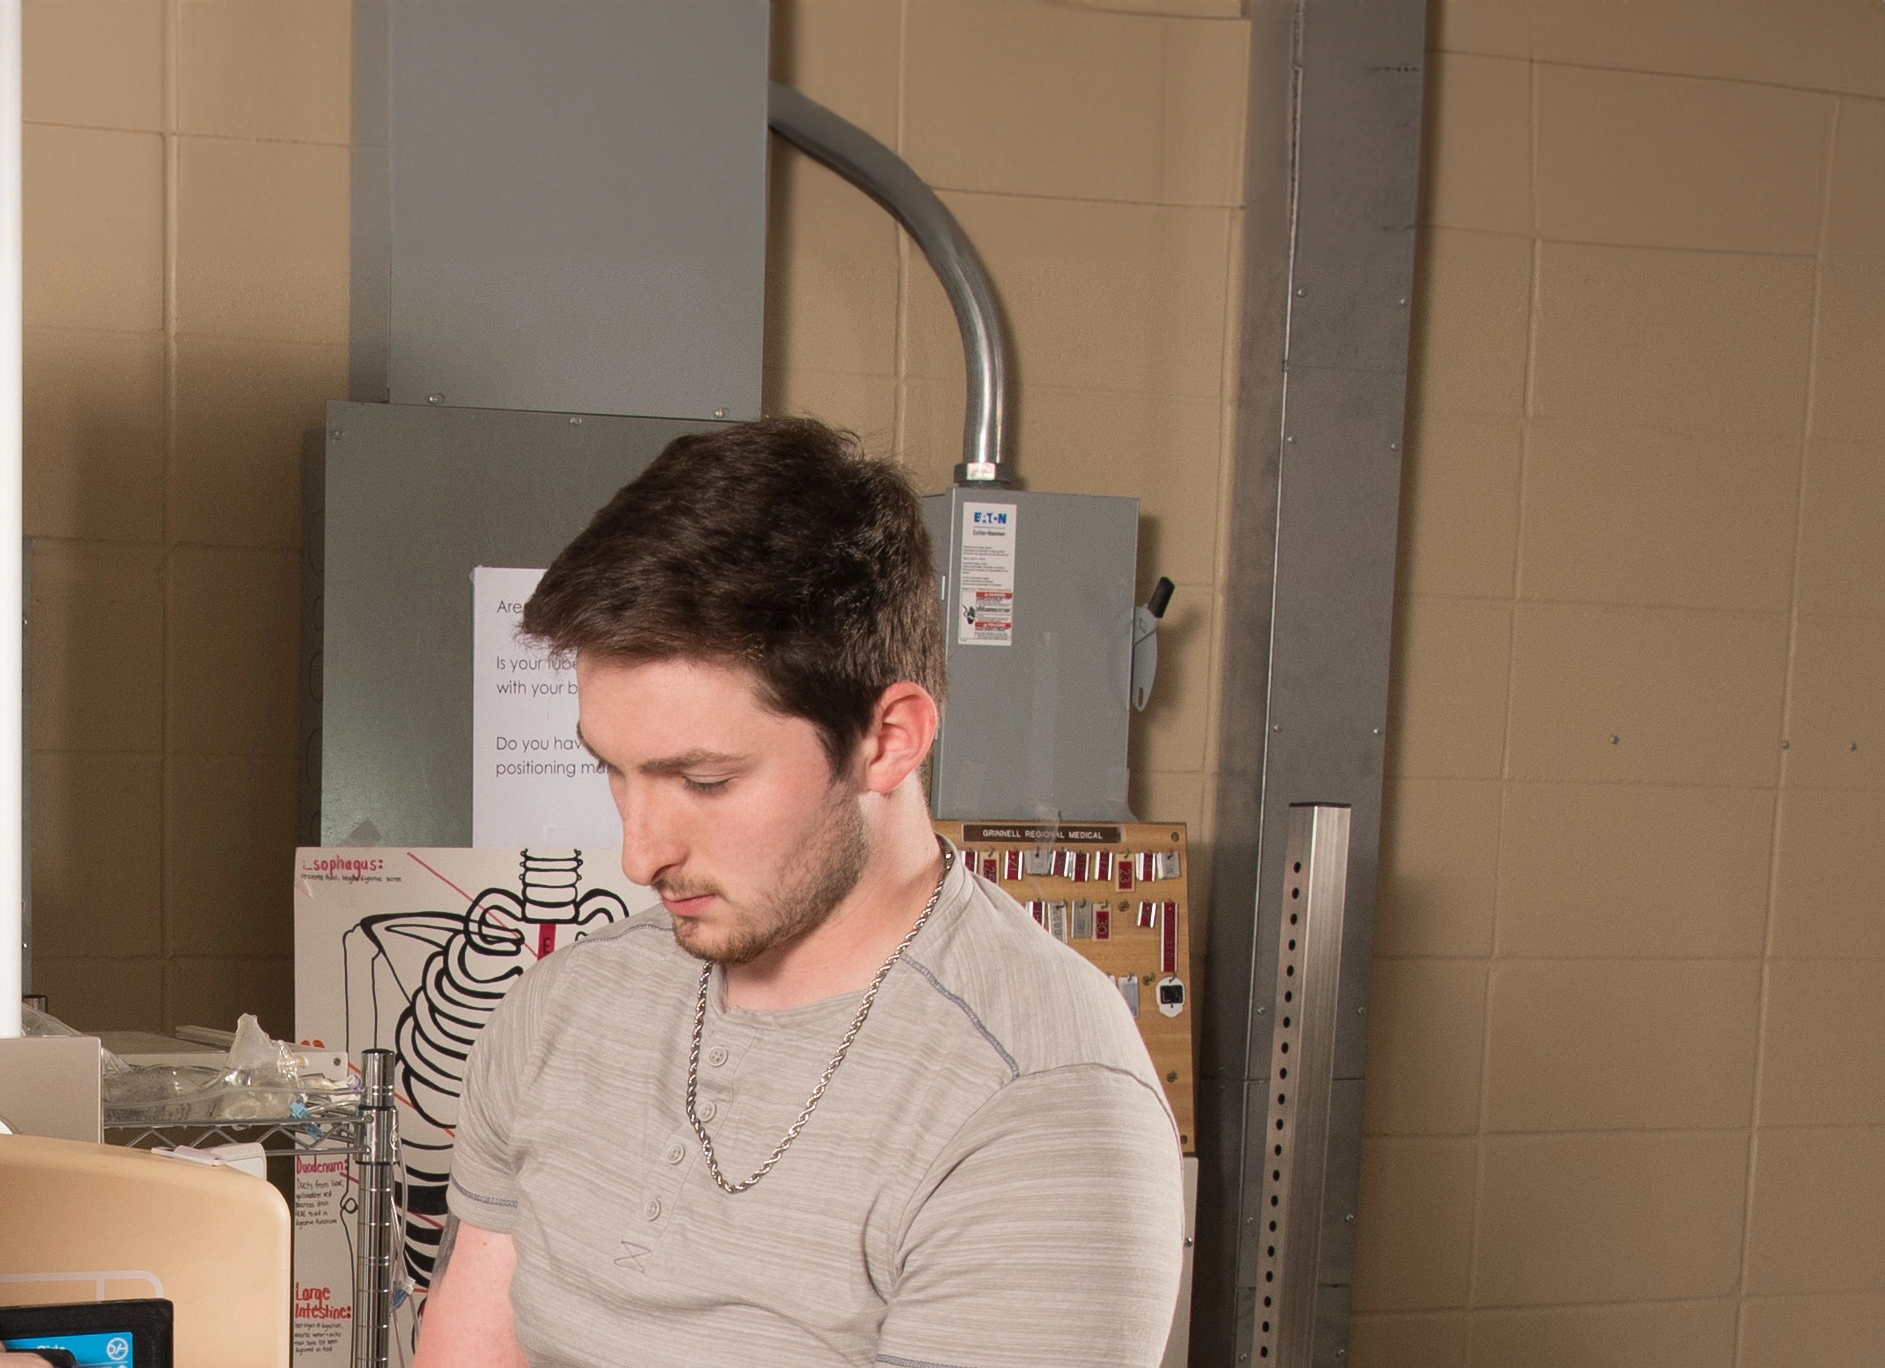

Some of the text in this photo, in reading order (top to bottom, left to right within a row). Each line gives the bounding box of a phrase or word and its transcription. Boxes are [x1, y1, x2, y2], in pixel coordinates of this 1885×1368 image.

[497, 600, 522, 614] Are
[497, 656, 506, 670] Is
[510, 658, 543, 673] your
[497, 680, 526, 695] with
[531, 683, 564, 698] your
[496, 736, 518, 751] Do
[522, 738, 549, 754] you
[496, 760, 576, 777] positioning
[982, 829, 1021, 838] GRINNELL
[1068, 830, 1103, 840] MEDICAL
[1096, 917, 1108, 935] 30
[295, 1281, 331, 1308] Large
[295, 1303, 352, 1319] Intestine:
